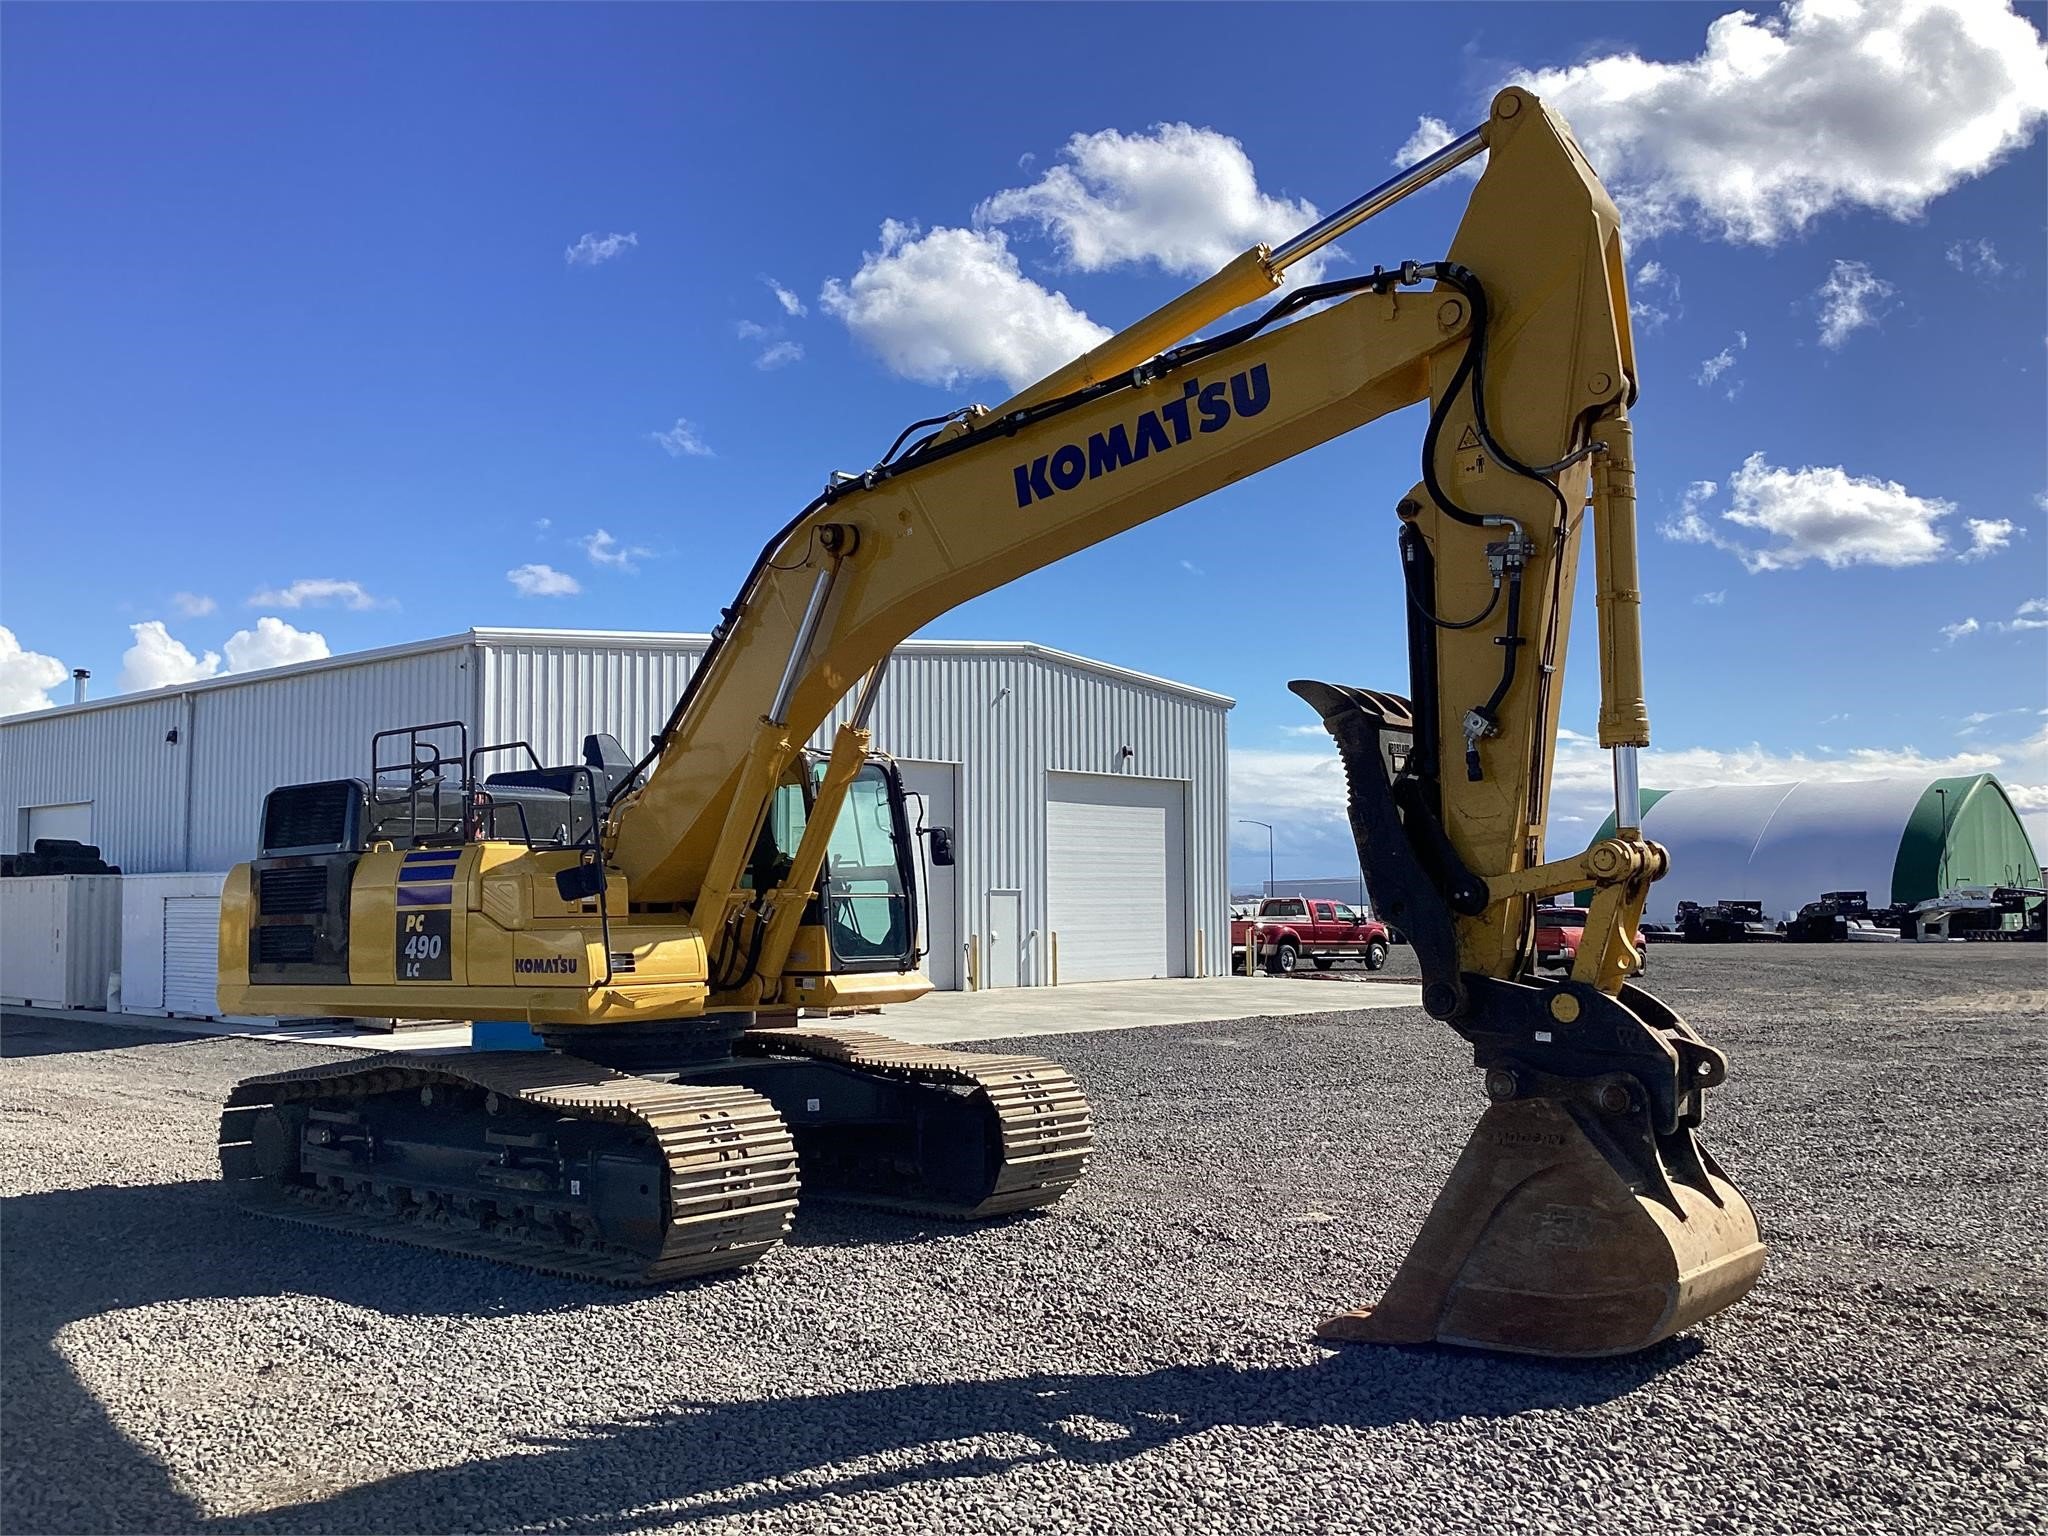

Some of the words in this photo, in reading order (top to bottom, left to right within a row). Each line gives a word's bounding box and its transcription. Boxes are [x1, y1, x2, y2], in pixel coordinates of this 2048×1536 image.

[1013, 363, 1271, 508] KOMATSU
[405, 914, 425, 933] PC
[404, 935, 442, 960] 490
[406, 962, 420, 977] LC
[515, 954, 578, 974] KOMATSU
